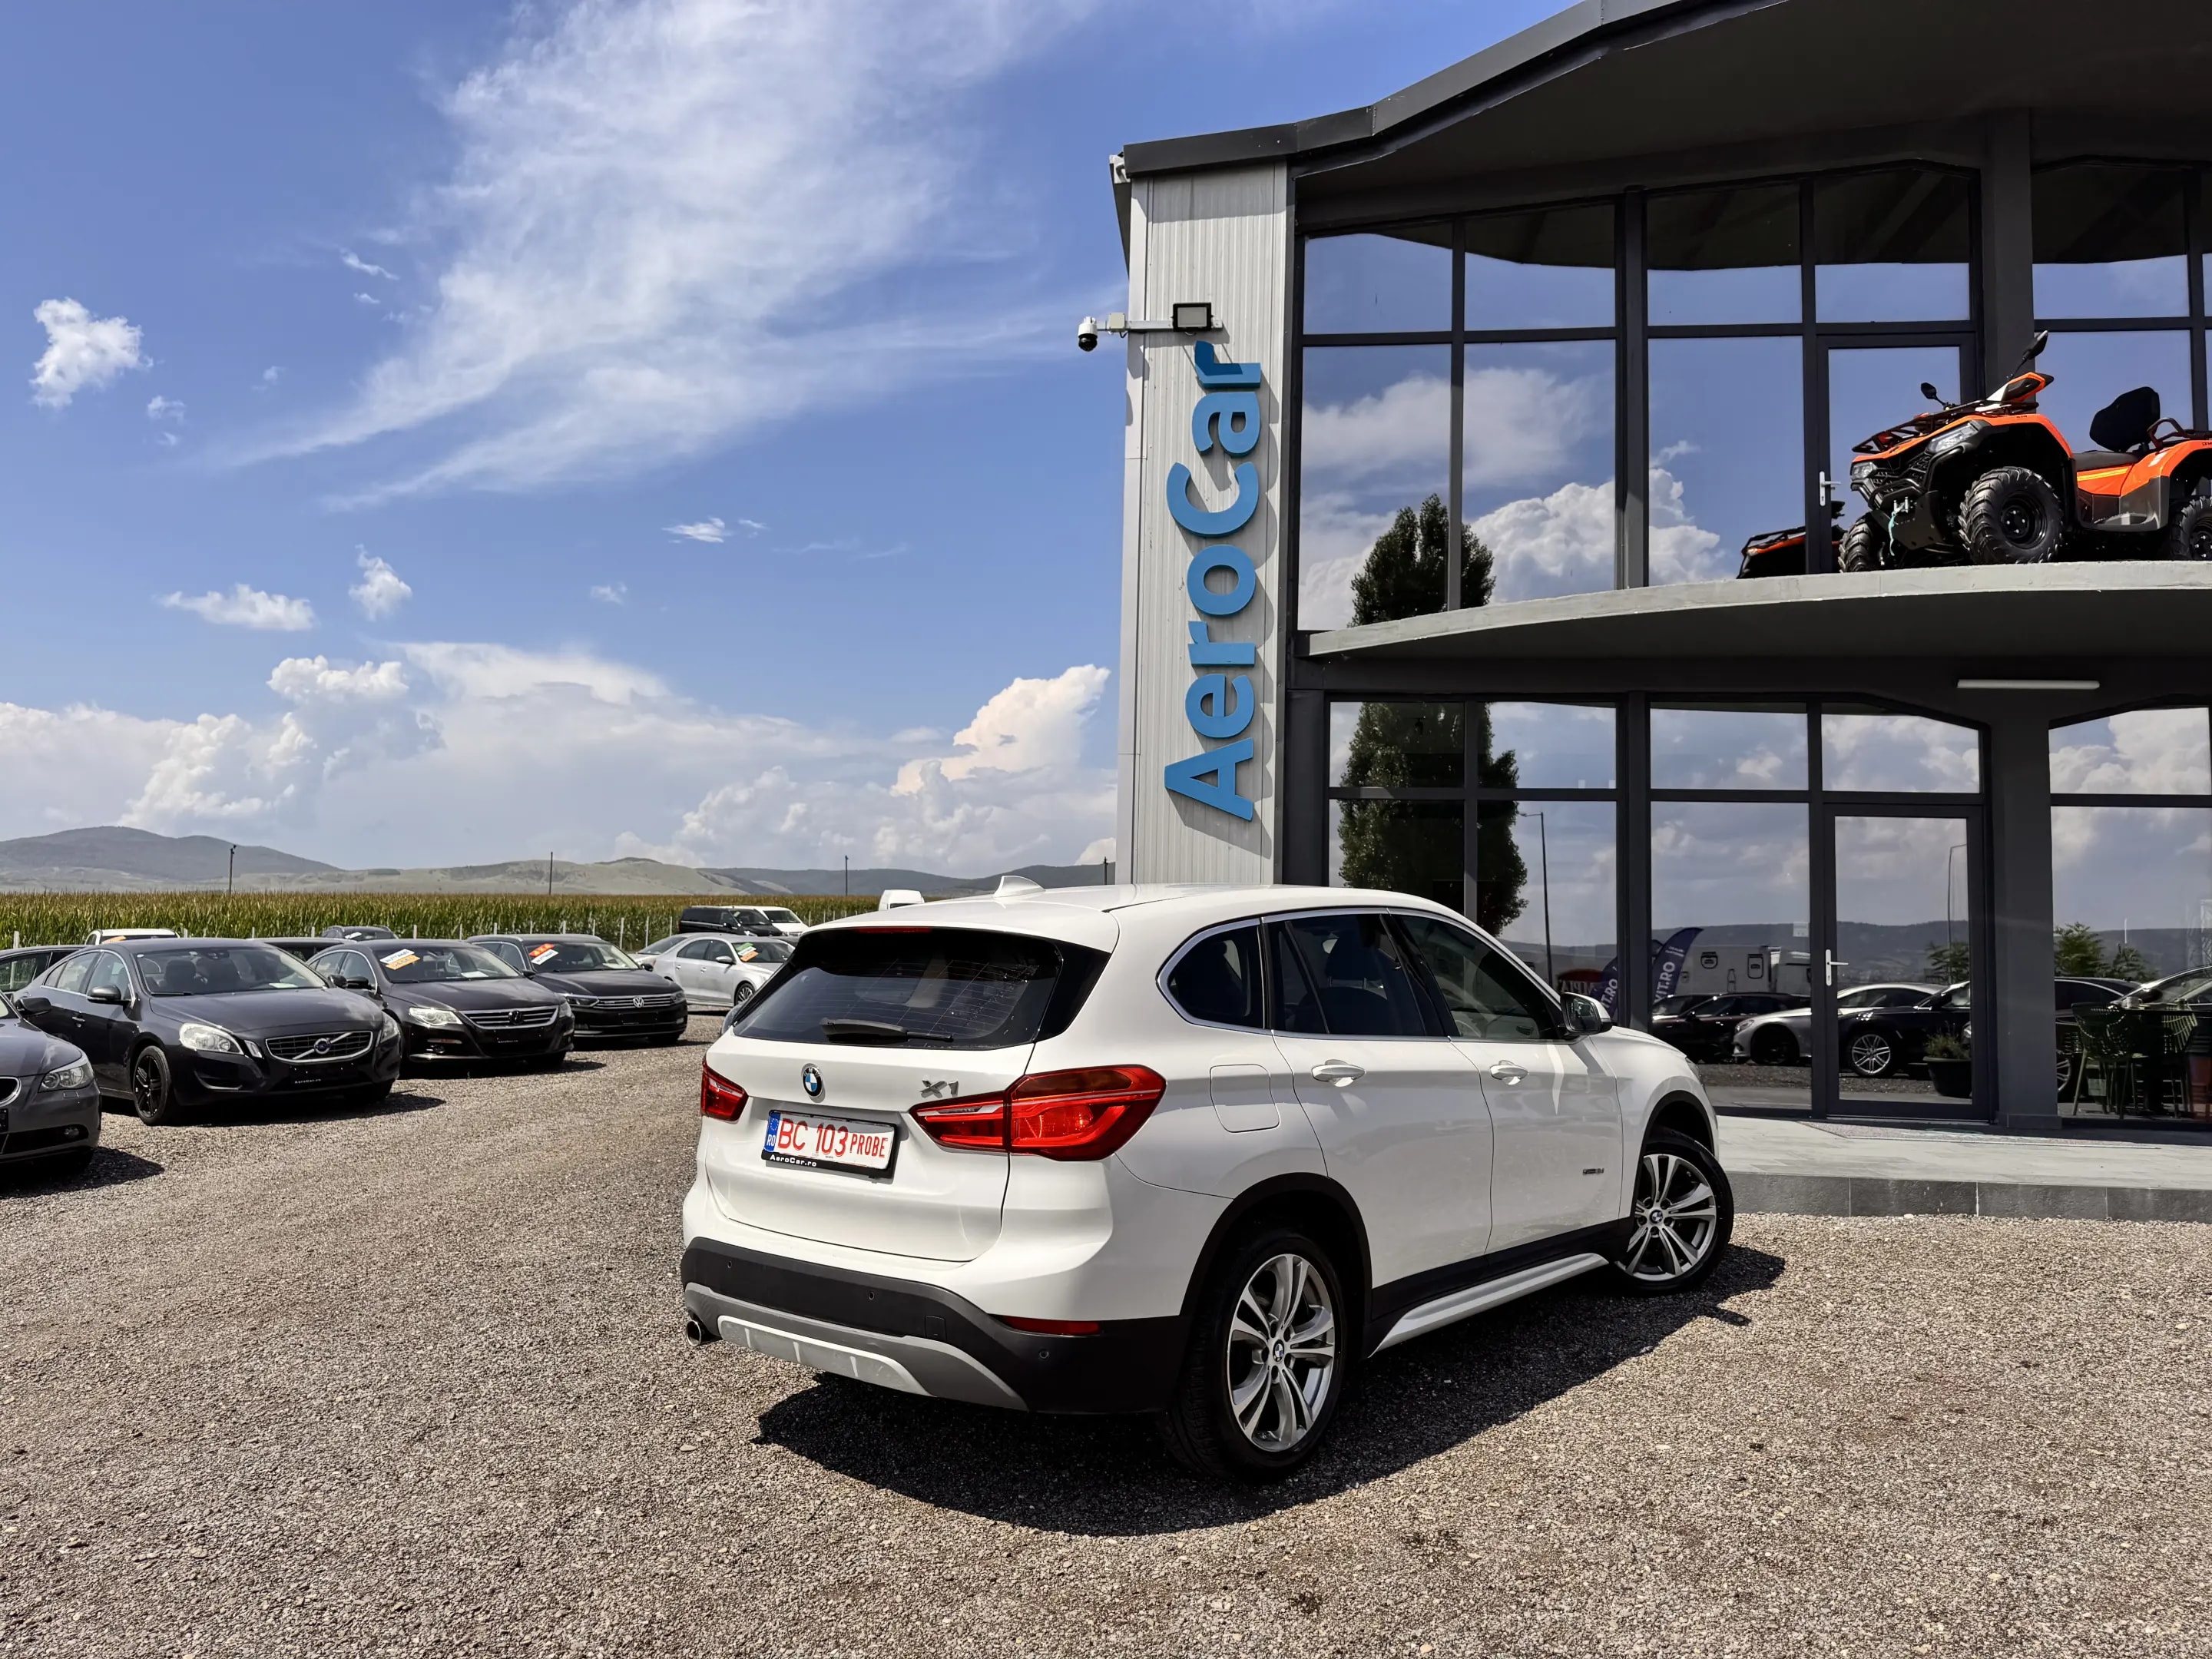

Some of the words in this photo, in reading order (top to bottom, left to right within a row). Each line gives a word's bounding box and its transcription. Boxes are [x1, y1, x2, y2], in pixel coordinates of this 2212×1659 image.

[1164, 339, 1262, 821] AeroCar
[1601, 979, 1618, 1008] IT.RO
[1654, 962, 1675, 1003] VIT.RO
[919, 1080, 959, 1098] X1
[767, 1134, 776, 1147] RO
[777, 1118, 808, 1151] BC
[815, 1122, 849, 1157] 103
[849, 1133, 888, 1157] PROBE
[770, 1154, 817, 1167] AeroCar.ro
